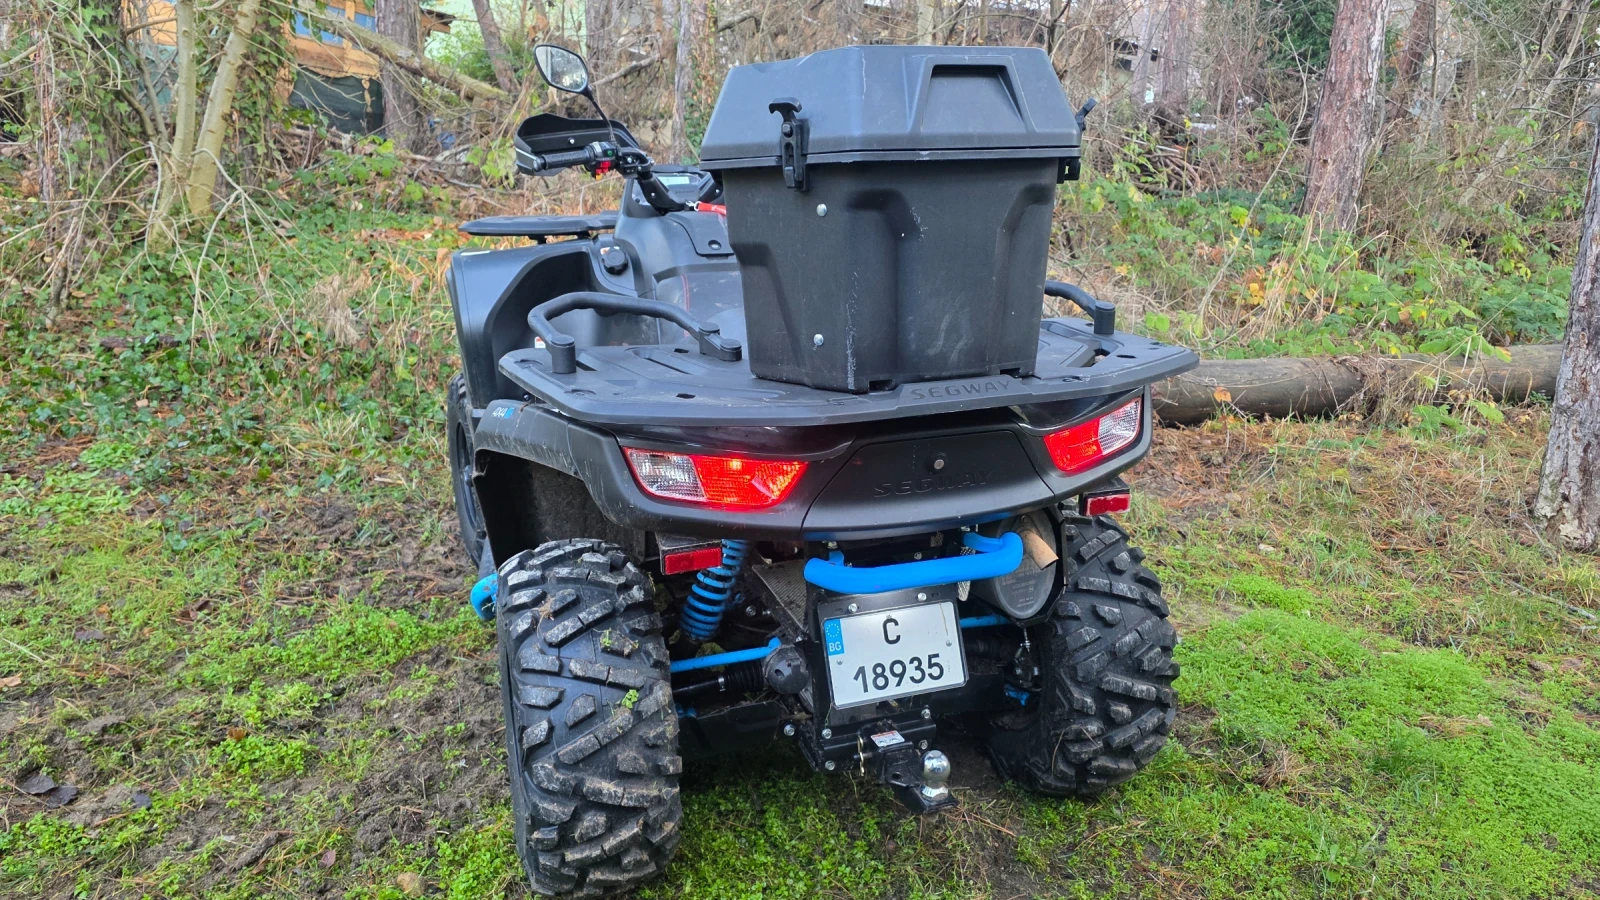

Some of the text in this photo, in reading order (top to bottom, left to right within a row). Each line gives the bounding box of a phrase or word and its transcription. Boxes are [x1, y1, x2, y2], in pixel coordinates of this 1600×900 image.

[910, 380, 1011, 400] SEGWAY
[873, 470, 993, 498] SEGWAY
[882, 618, 901, 645] C
[828, 641, 842, 653] BG
[853, 653, 944, 693] 18935
